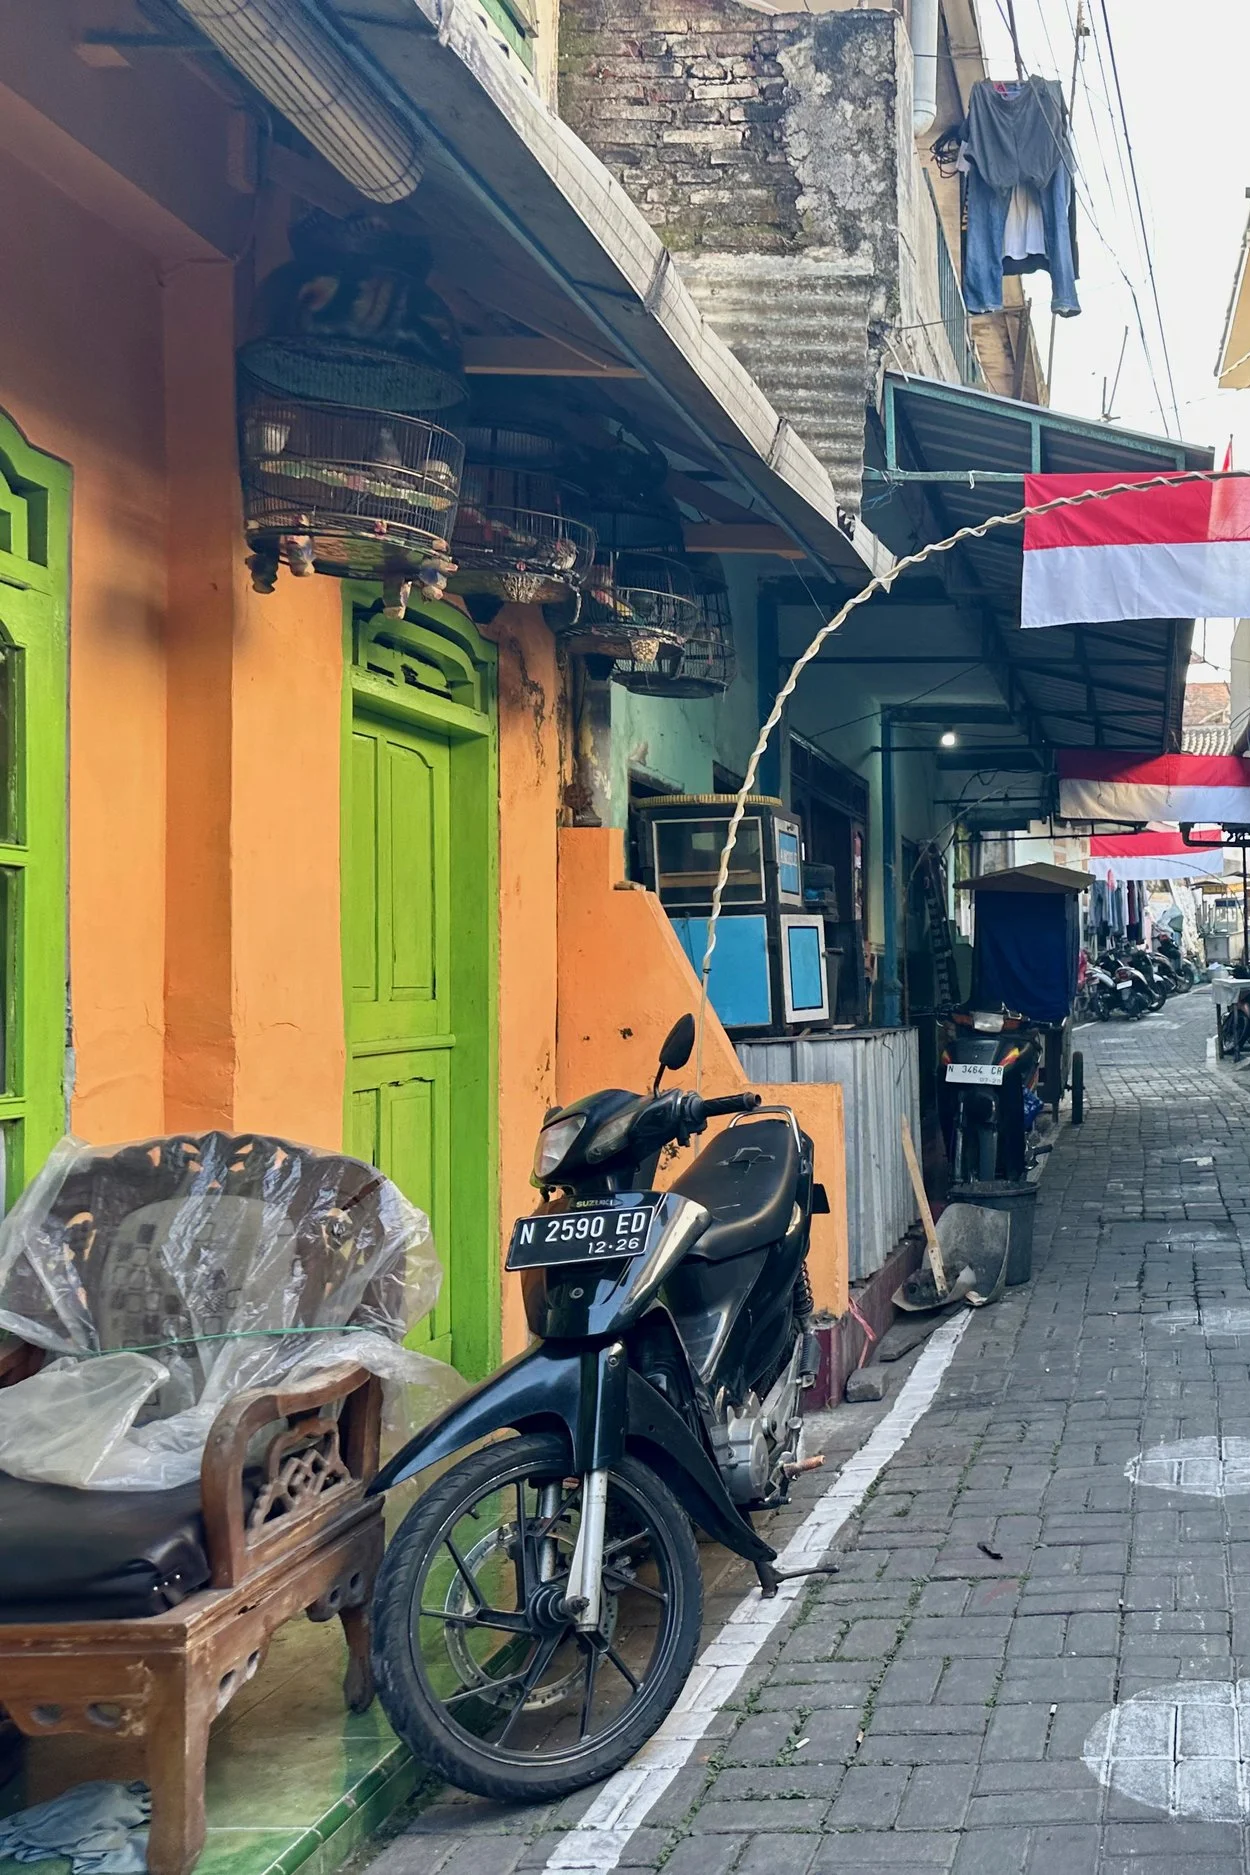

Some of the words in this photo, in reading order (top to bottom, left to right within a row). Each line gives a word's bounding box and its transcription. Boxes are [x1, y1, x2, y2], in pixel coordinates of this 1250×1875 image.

[948, 1065, 955, 1073] N
[990, 1066, 1003, 1075] CR
[575, 1199, 614, 1208] SUZUKI
[519, 1222, 535, 1245] N
[544, 1216, 605, 1243] 2590
[615, 1211, 646, 1235] ED
